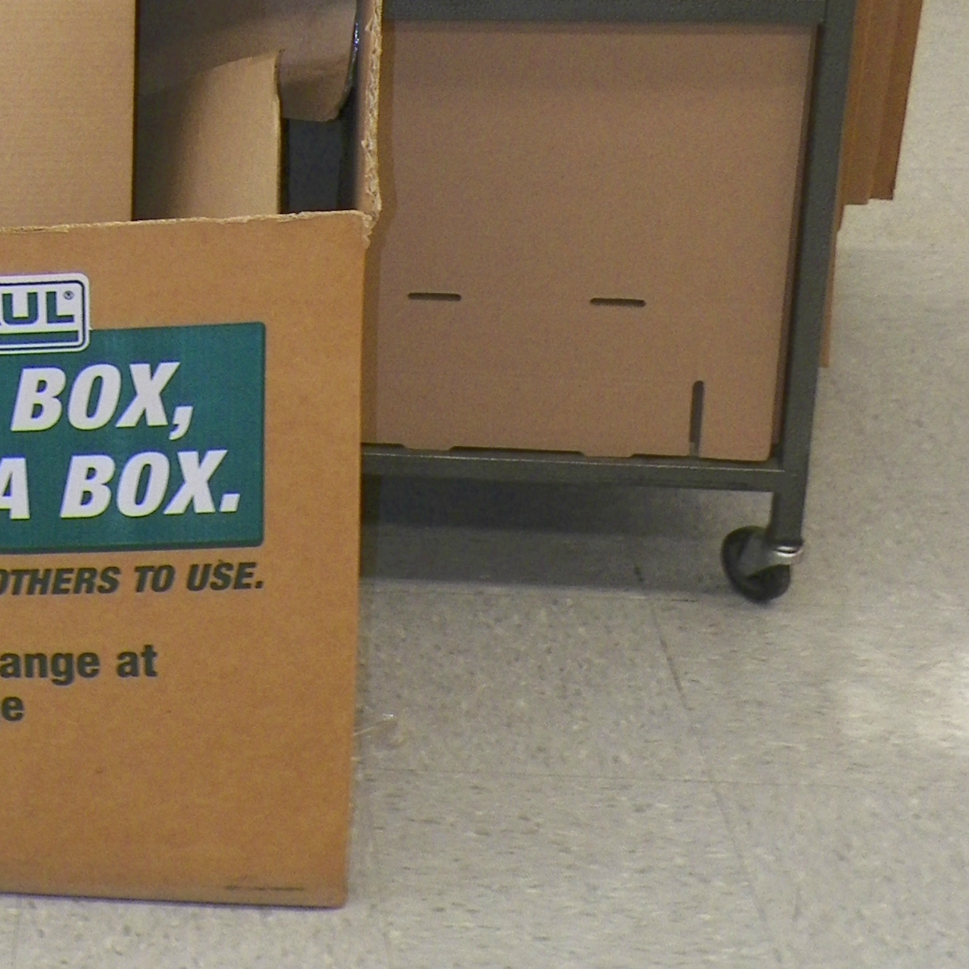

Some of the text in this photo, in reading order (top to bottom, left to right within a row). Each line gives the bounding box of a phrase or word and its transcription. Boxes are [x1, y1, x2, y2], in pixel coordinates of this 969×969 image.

[11, 362, 193, 441] BOX,
[60, 449, 240, 519] BOX.
[133, 564, 175, 593] TO
[186, 561, 264, 591] USE.
[116, 643, 158, 679] at
